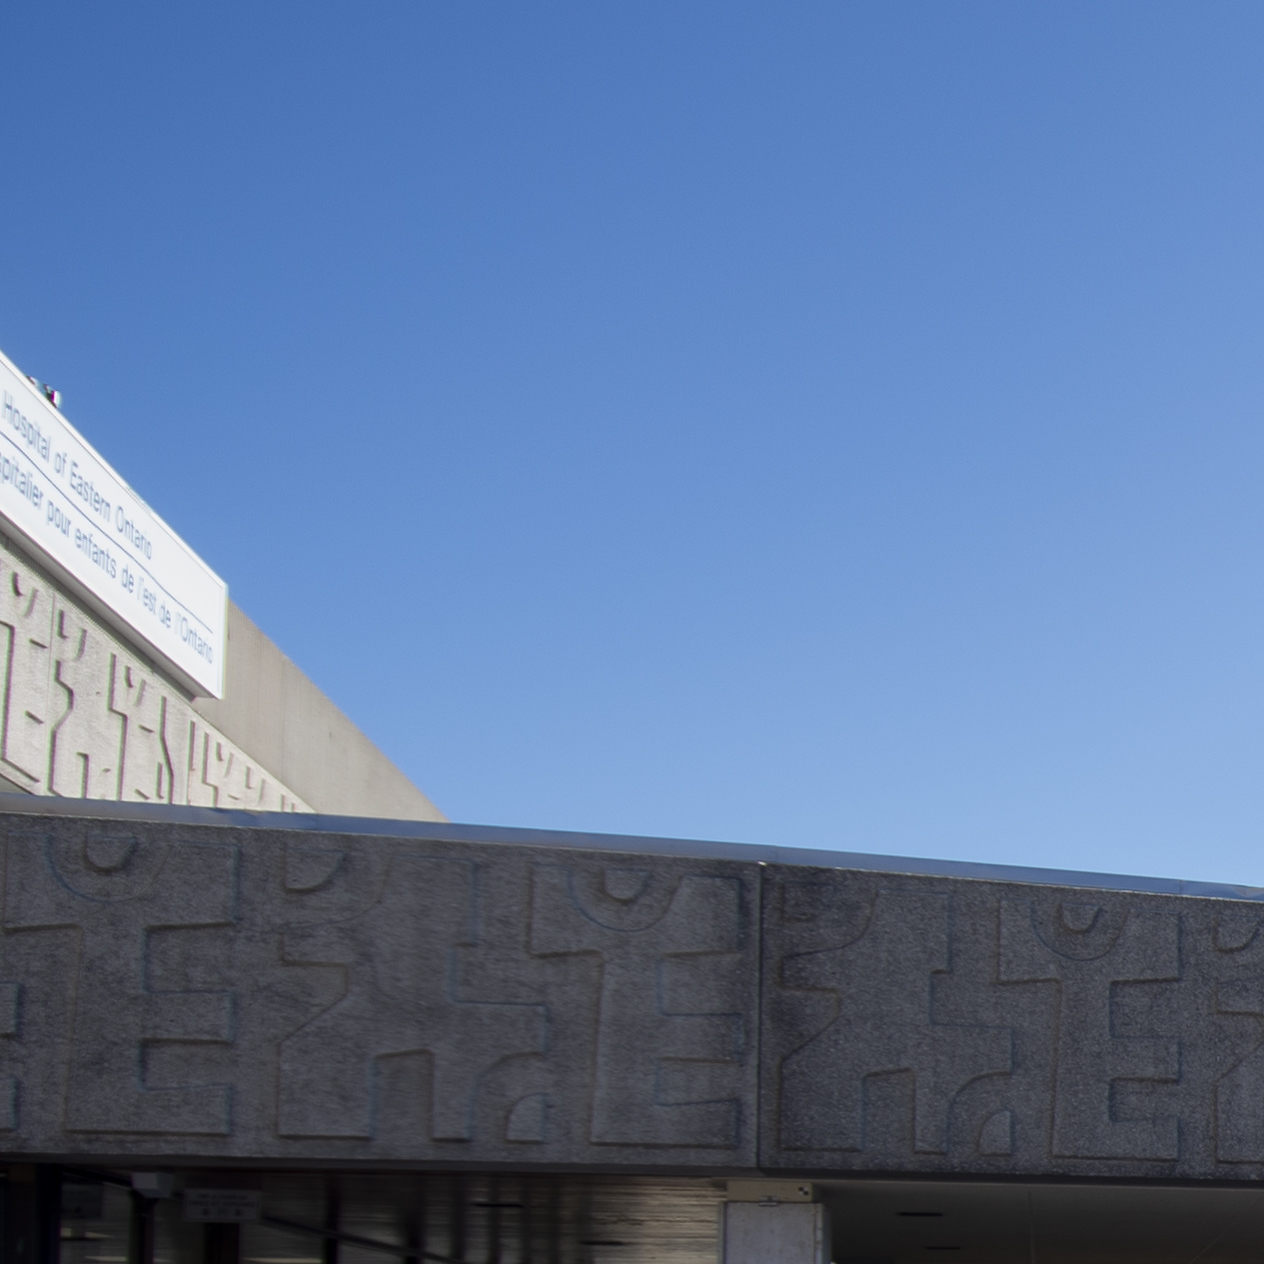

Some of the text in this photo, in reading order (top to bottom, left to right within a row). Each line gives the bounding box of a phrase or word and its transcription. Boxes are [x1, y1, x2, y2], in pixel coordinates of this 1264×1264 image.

[0, 452, 44, 510] pitalier
[47, 498, 72, 538] pour
[74, 527, 117, 579] enfants
[121, 563, 135, 594] de
[159, 600, 171, 629] de
[1, 389, 153, 560] Hospital of Eastern Ontario
